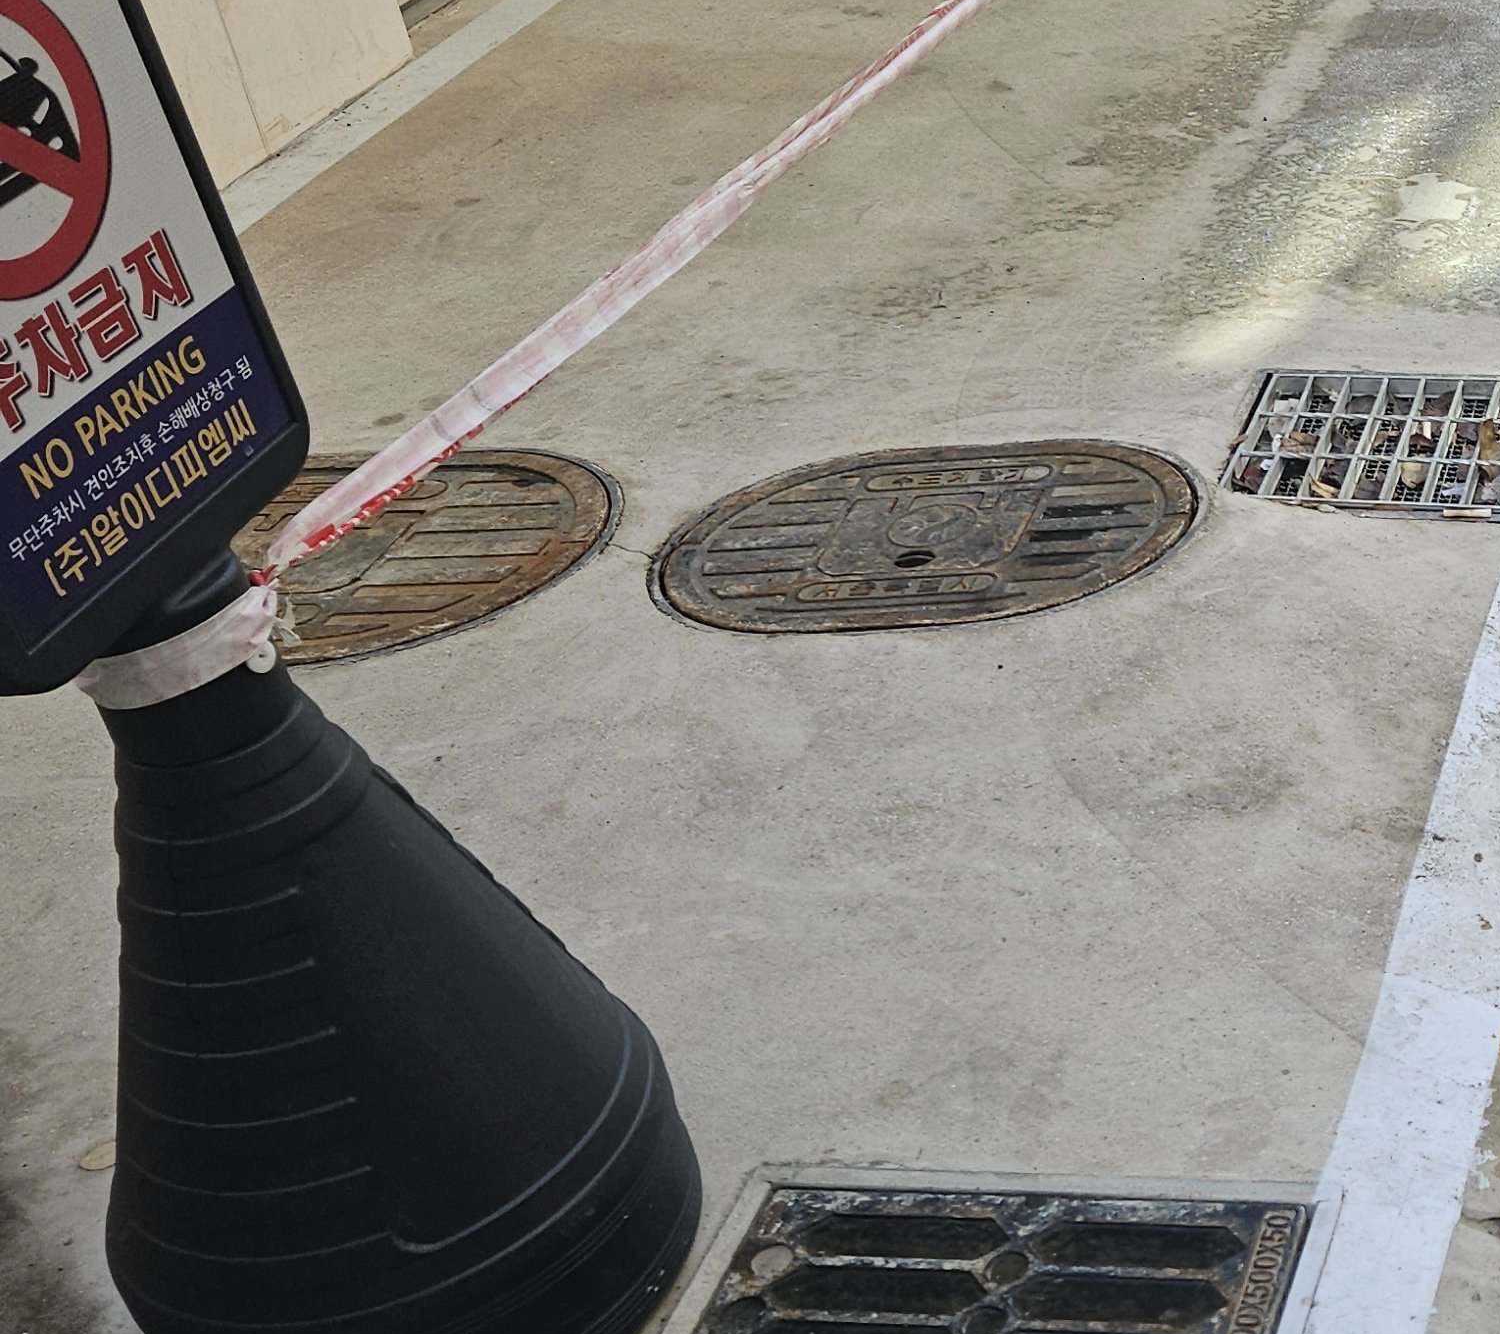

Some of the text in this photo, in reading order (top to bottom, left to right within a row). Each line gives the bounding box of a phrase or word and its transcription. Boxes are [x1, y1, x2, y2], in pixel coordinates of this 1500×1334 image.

[8, 354, 253, 561] 무단주차시 견인조치후 손해배상청구 됨
[19, 335, 207, 500] NO PARKING
[813, 575, 979, 599] 서울특별시
